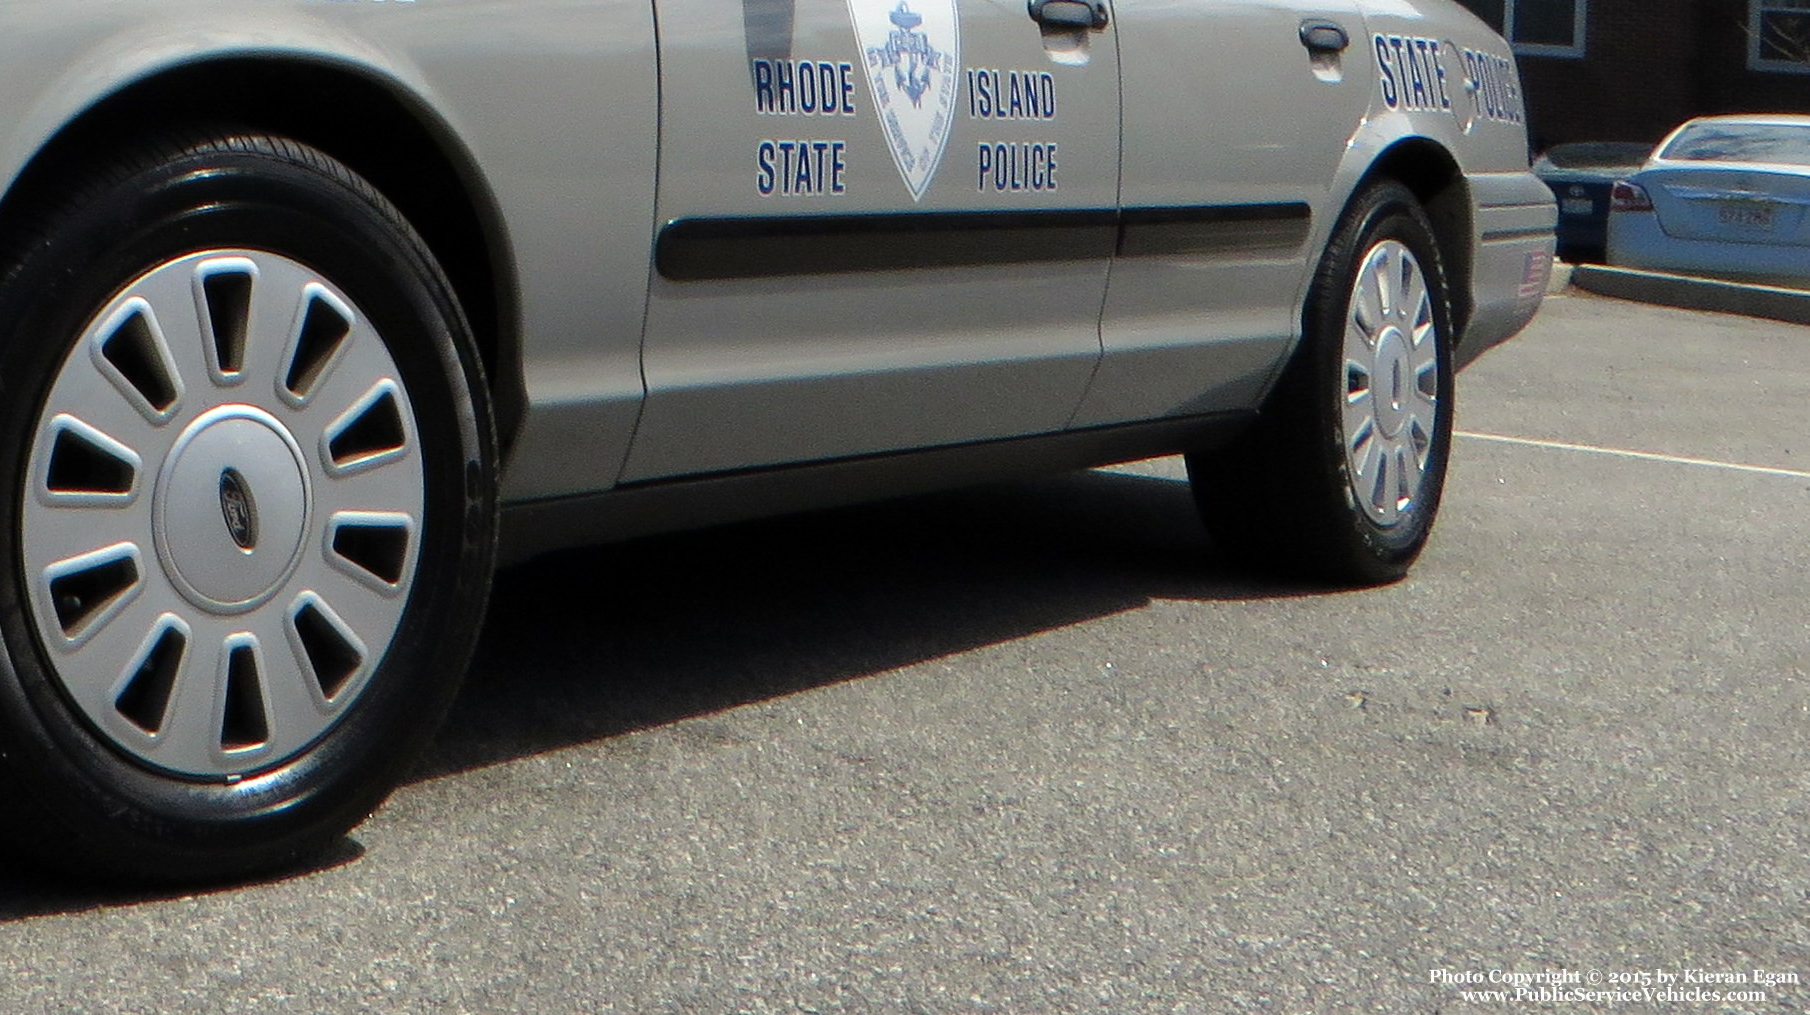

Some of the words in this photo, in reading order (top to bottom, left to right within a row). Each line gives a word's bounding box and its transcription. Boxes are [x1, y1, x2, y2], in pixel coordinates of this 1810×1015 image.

[753, 59, 856, 115] RHODE
[968, 67, 1055, 119] ISLAND
[1374, 33, 1450, 112] STATE
[1463, 46, 1524, 127] POLICE
[757, 140, 846, 196] STATE
[977, 142, 1059, 191] POLICE
